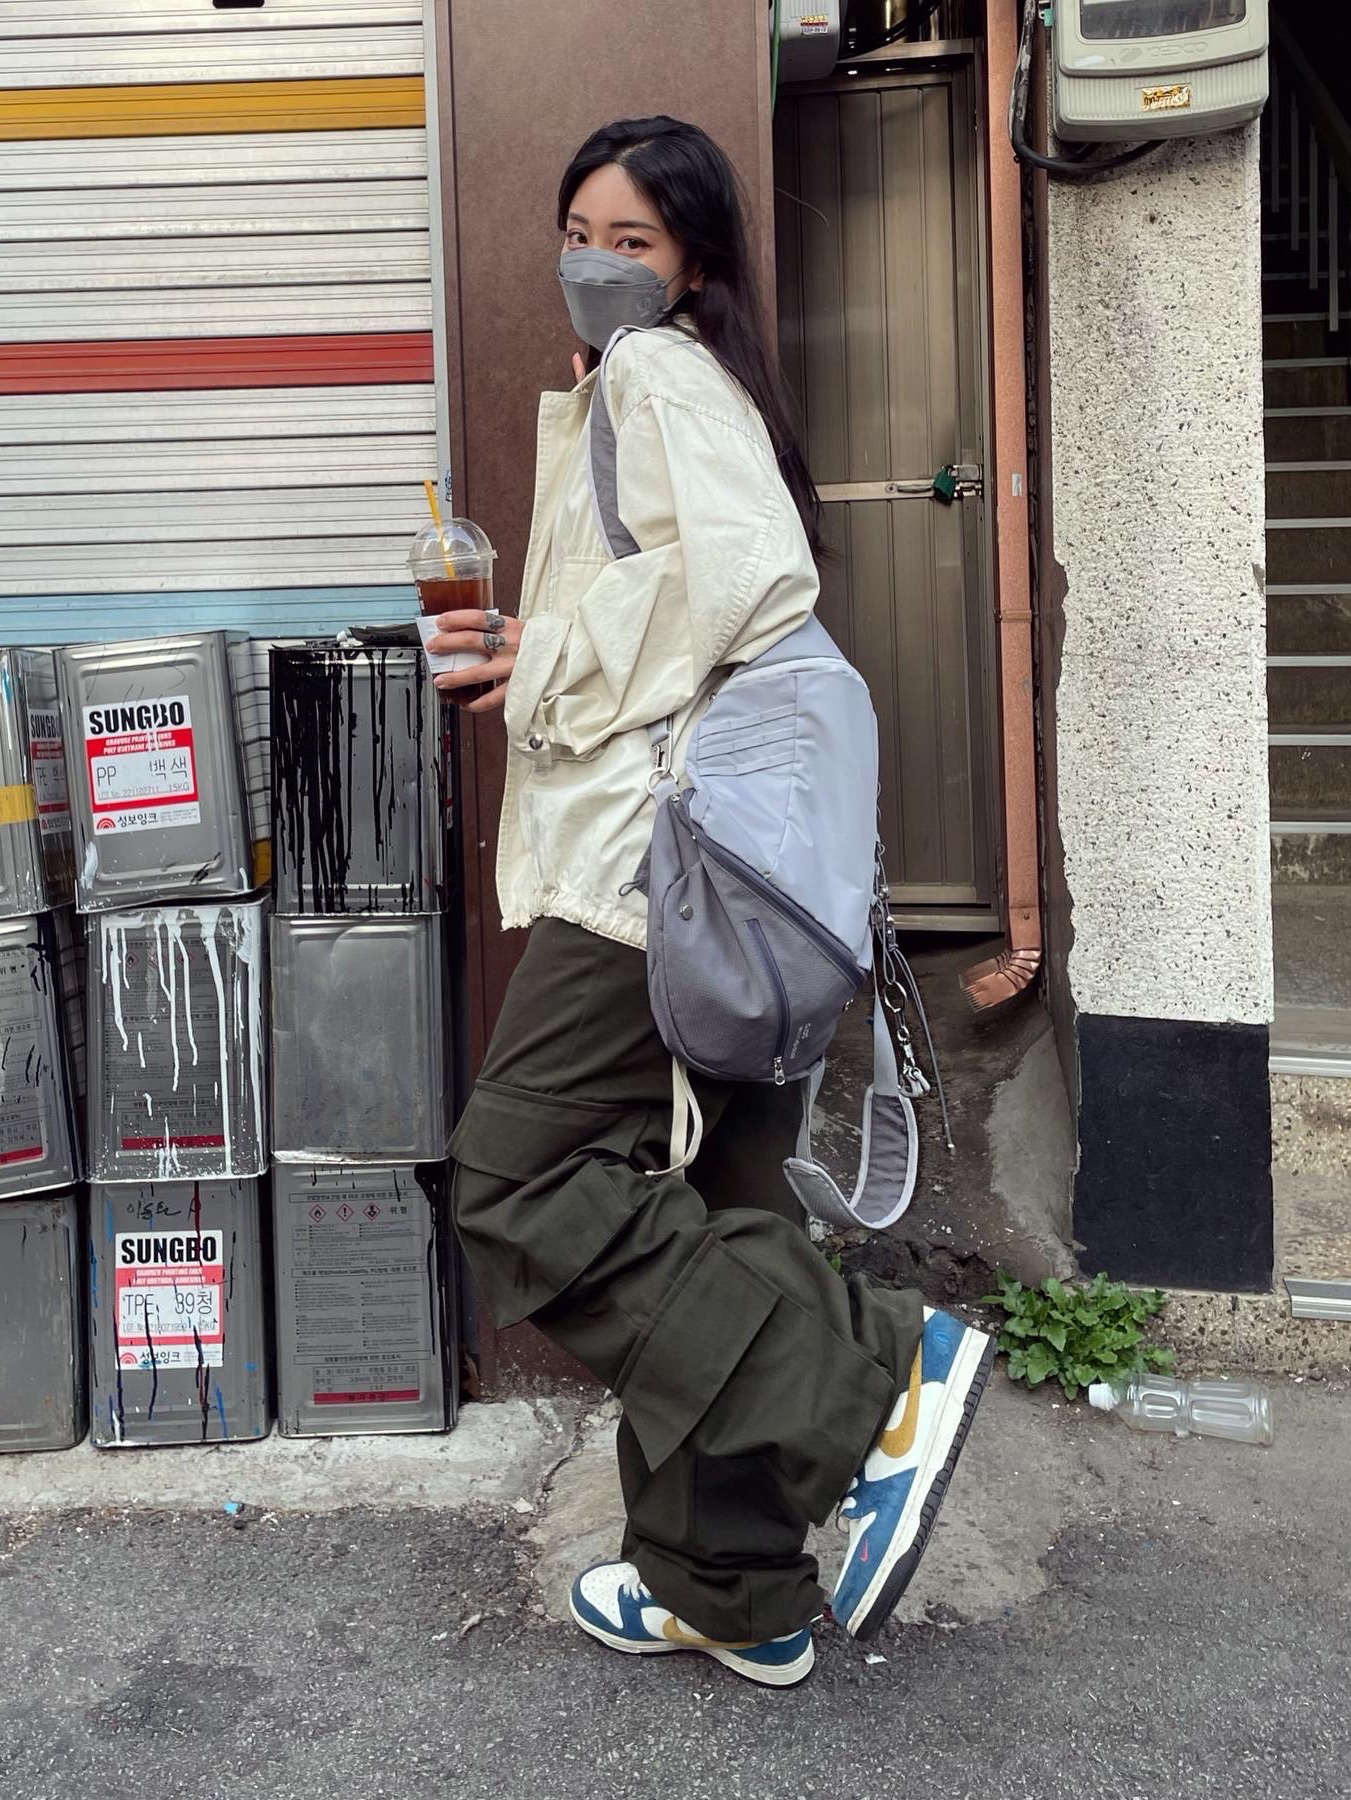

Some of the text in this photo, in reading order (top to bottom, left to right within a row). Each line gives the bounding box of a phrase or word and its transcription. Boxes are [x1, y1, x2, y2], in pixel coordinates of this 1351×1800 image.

[89, 701, 185, 735] SUNGBO
[96, 765, 116, 787] PP
[117, 812, 159, 828] 성보잉크
[121, 1236, 217, 1264] SUNGBO
[125, 1293, 154, 1315] TPE
